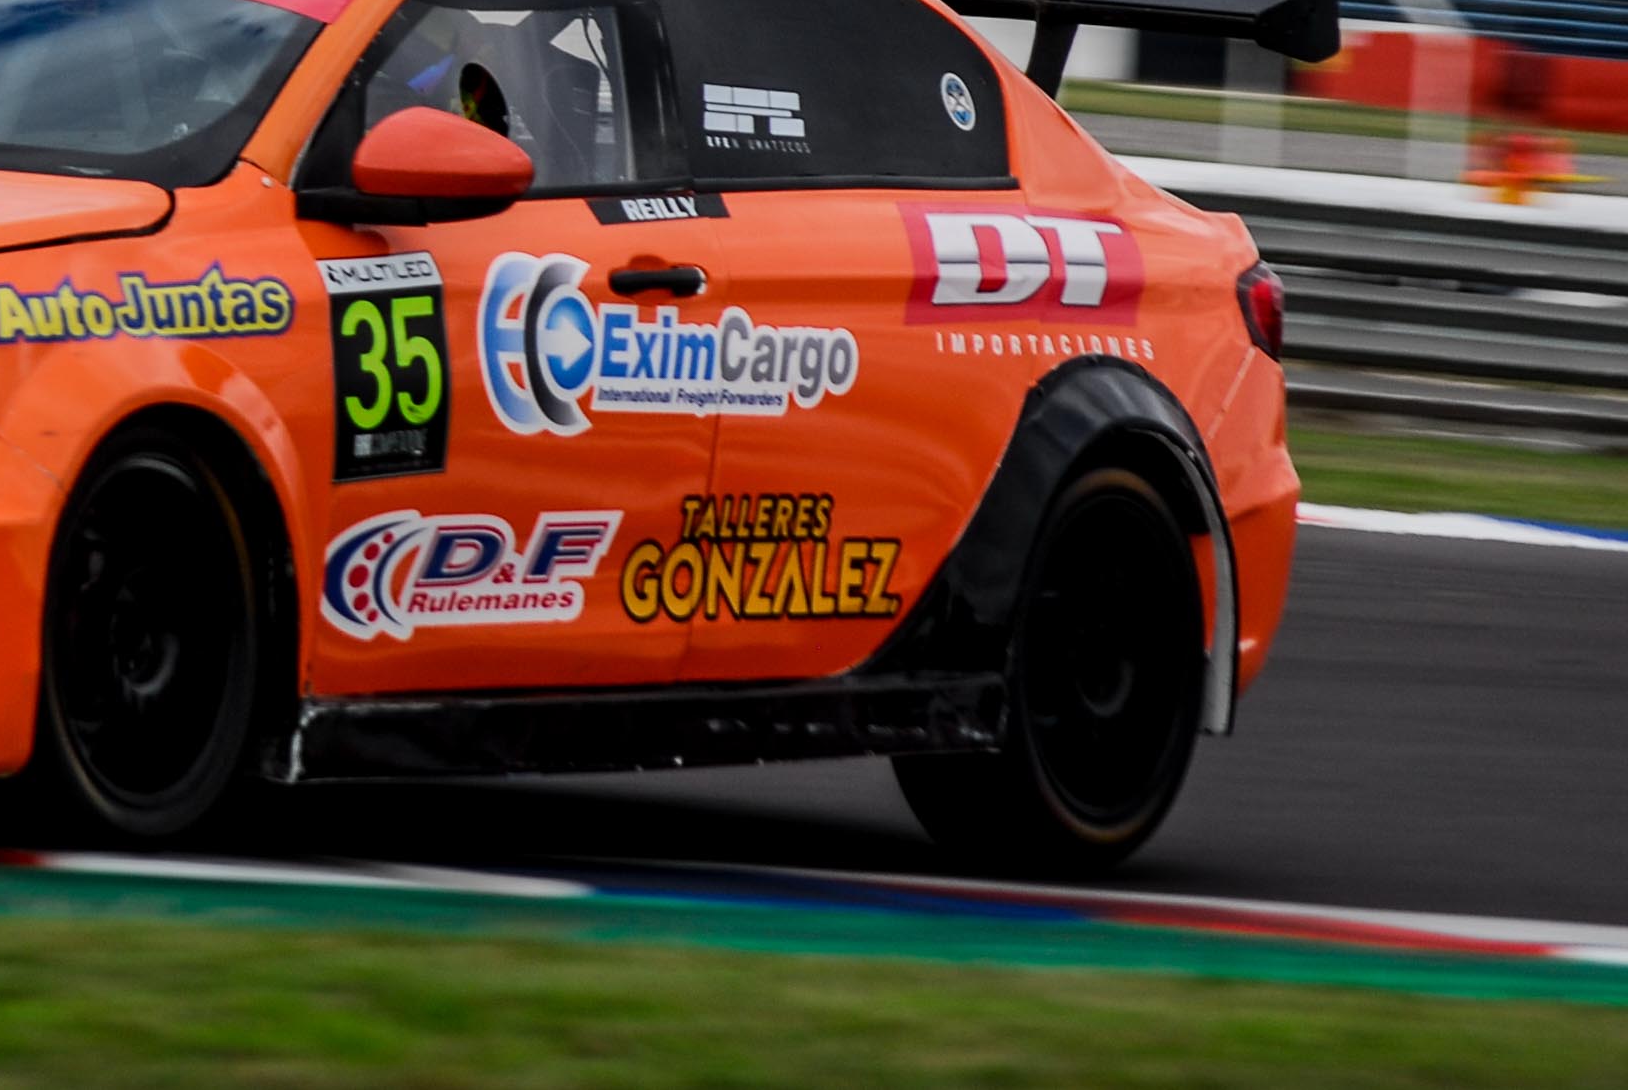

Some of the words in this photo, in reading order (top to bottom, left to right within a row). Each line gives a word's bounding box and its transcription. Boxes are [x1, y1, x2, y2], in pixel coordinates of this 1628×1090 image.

[620, 196, 699, 221] REILLY
[924, 212, 1123, 307] DT
[341, 295, 443, 429] 35
[599, 312, 854, 399] EximCargo
[935, 331, 1155, 360] IMPORTACIONES
[682, 497, 832, 539] TALLERES
[416, 522, 608, 587] D&F
[407, 589, 576, 616] Rulemanes
